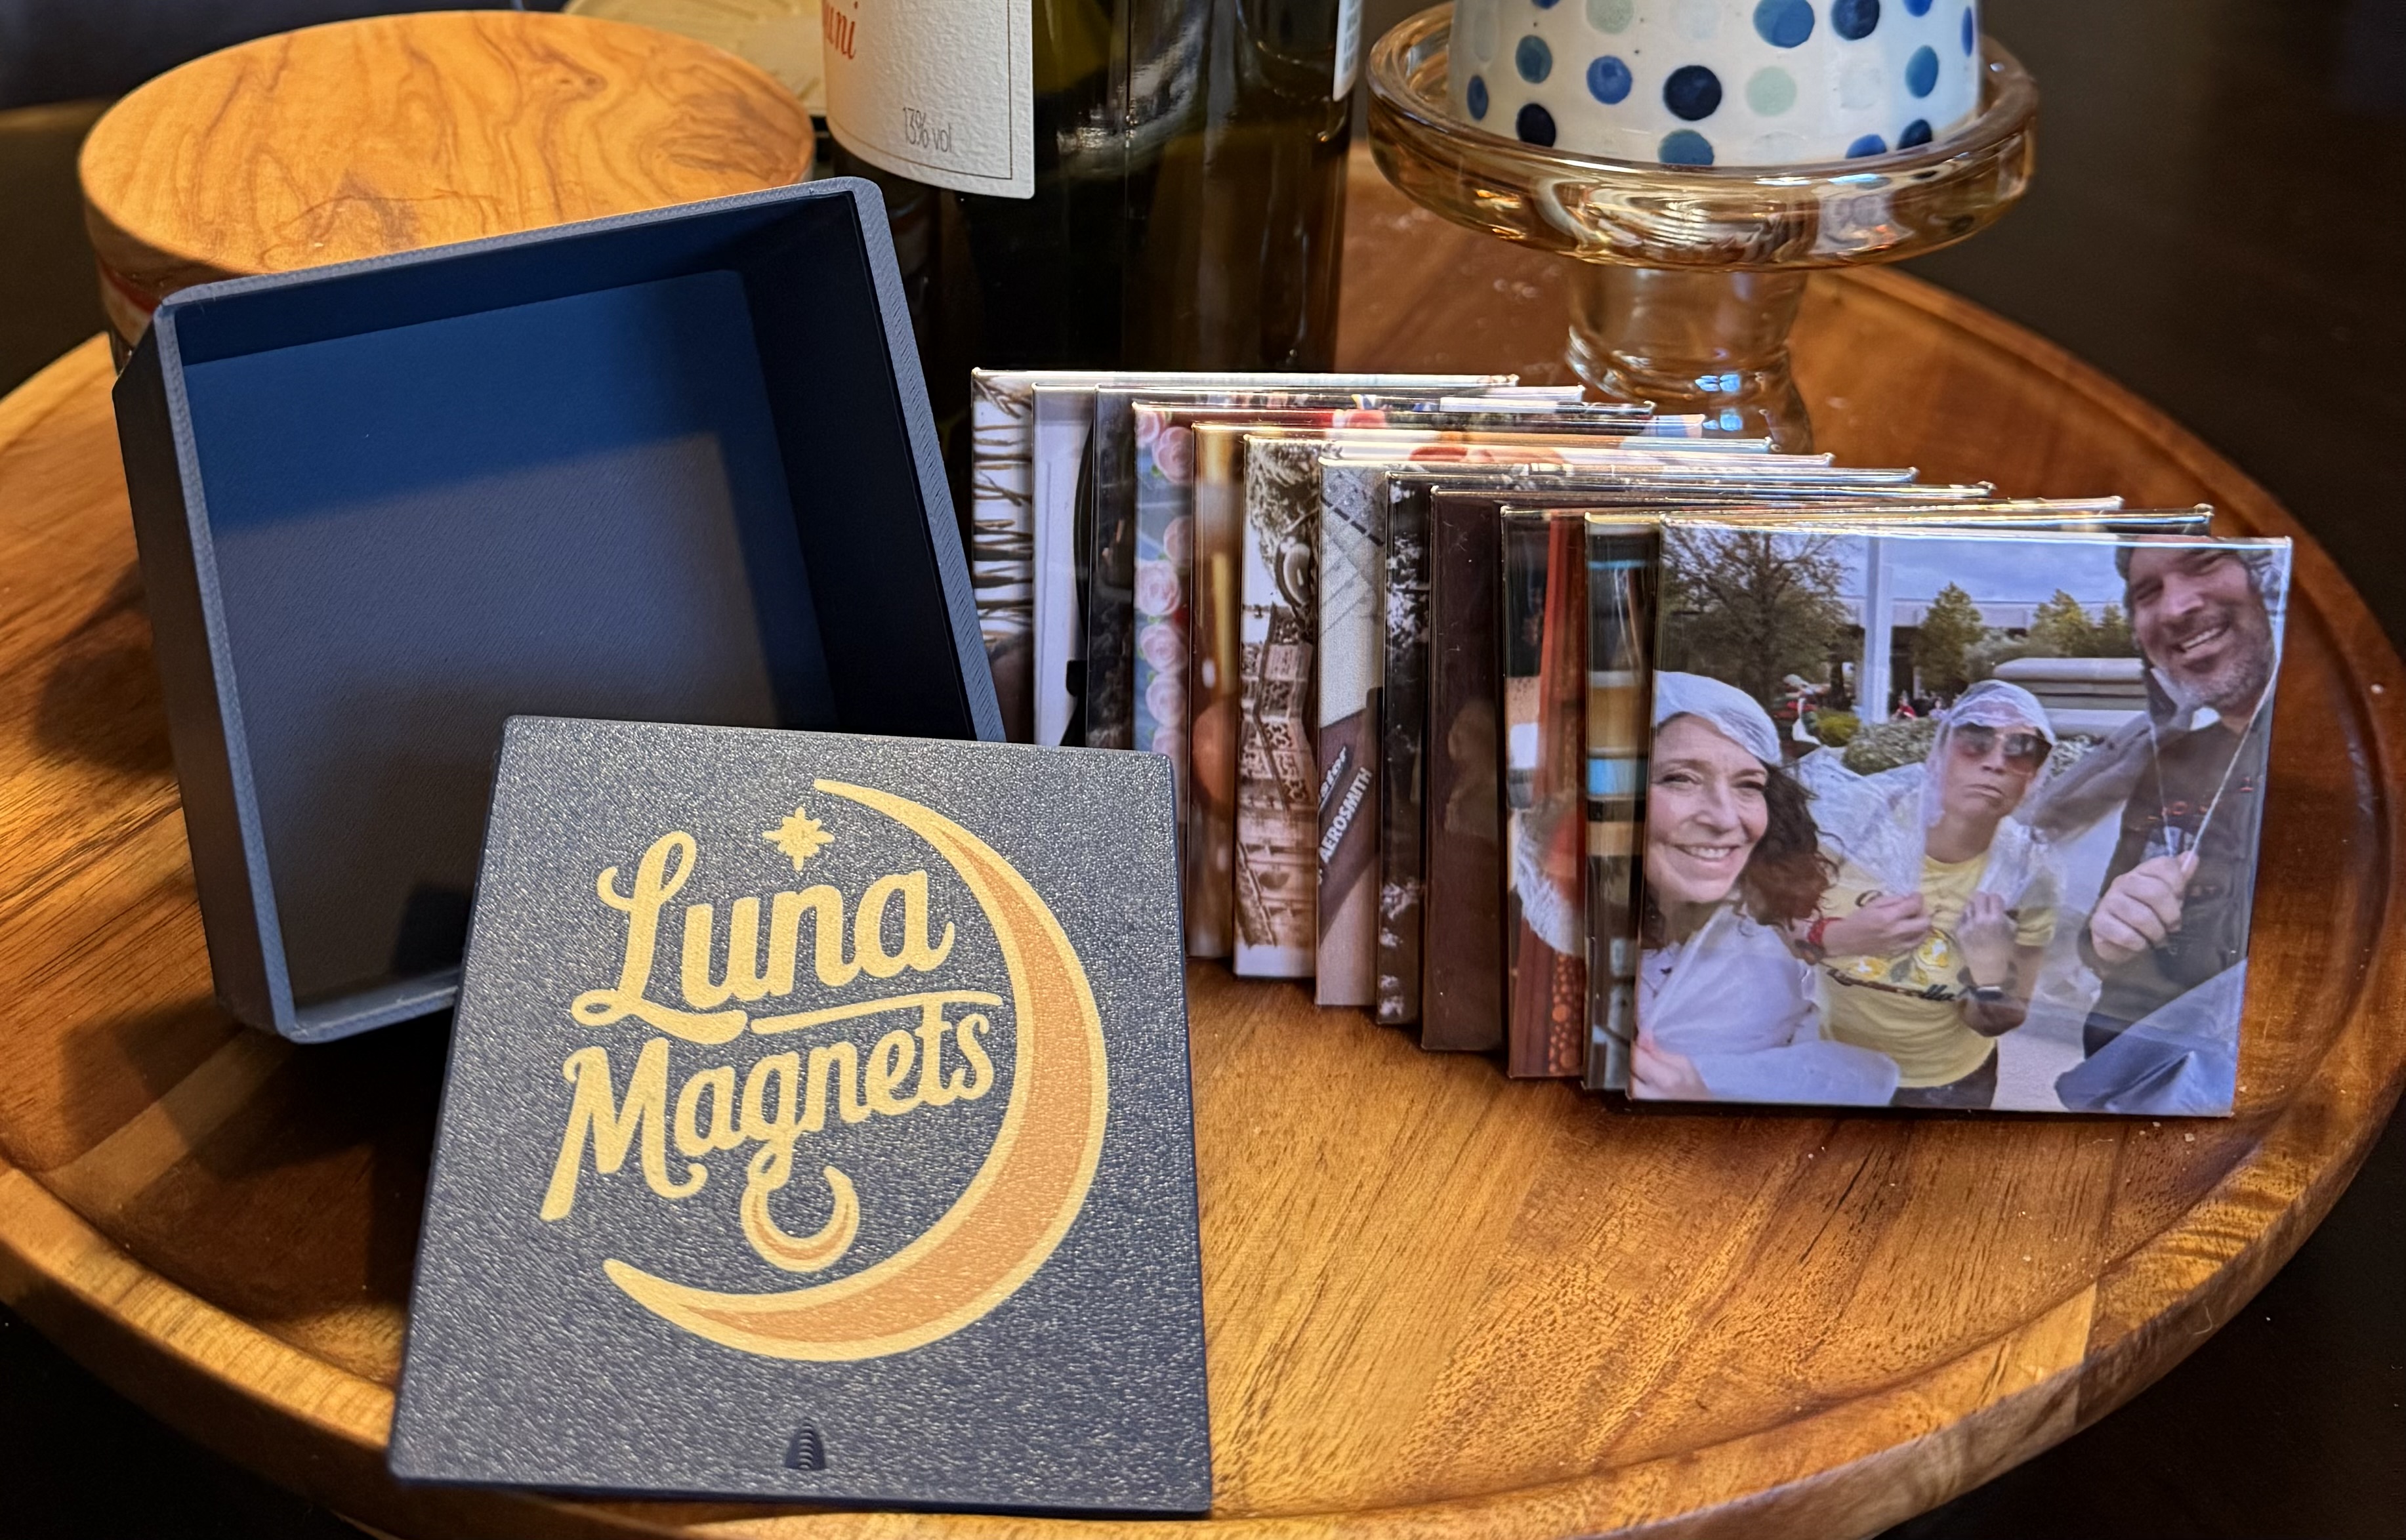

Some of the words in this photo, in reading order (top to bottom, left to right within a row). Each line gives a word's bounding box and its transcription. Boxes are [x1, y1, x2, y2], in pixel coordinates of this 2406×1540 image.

[902, 107, 929, 148] 13%
[932, 123, 952, 153] vol
[1319, 766, 1373, 864] AEROSMITH
[570, 830, 954, 1045] Luna
[540, 990, 1003, 1222] Magnets
